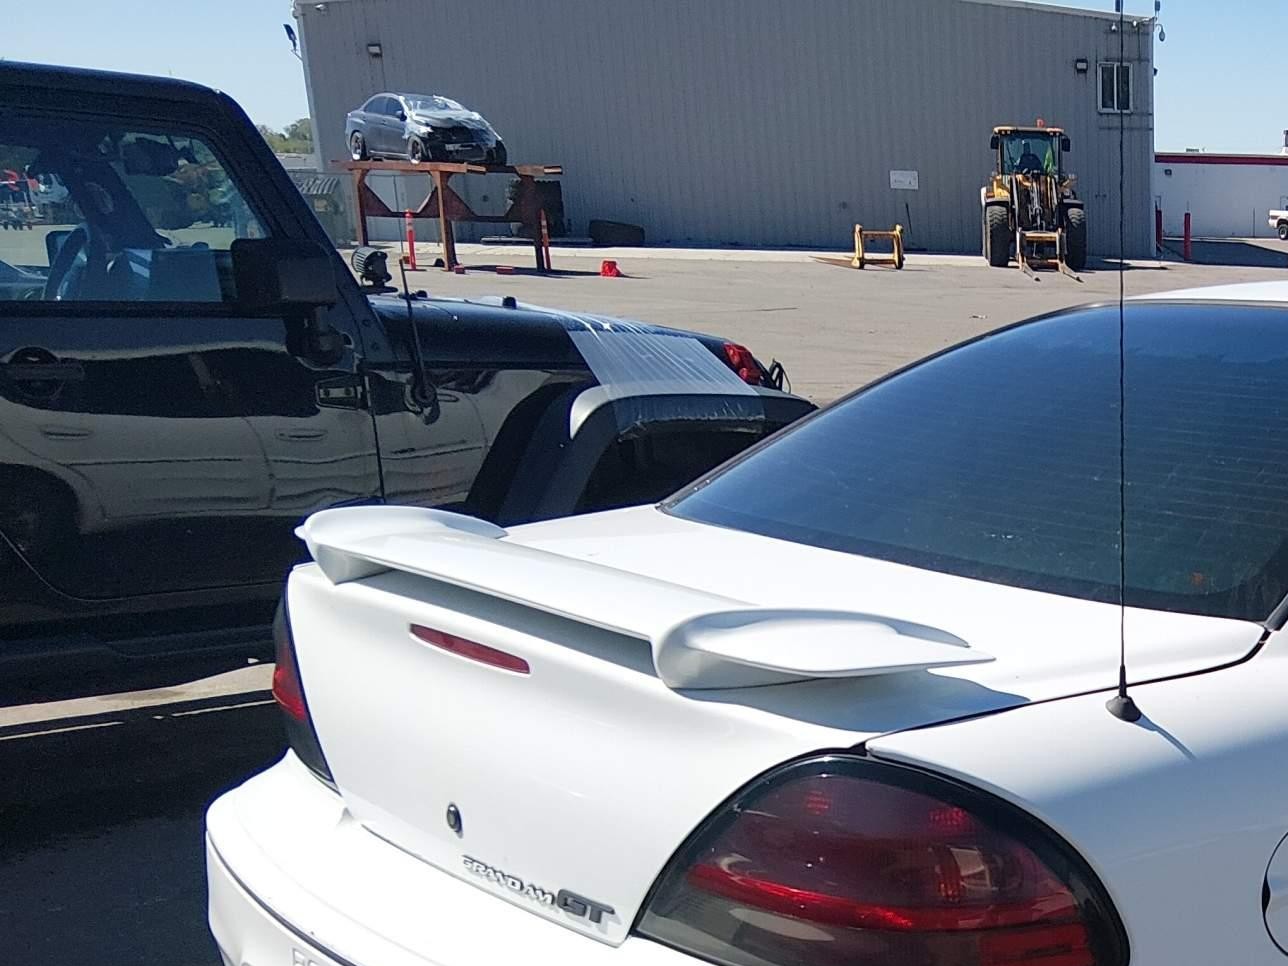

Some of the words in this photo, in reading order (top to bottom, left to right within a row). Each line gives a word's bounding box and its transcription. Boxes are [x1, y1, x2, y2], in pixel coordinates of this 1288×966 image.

[462, 854, 525, 893] GRAND
[525, 883, 556, 906] AM
[556, 888, 616, 924] GT
